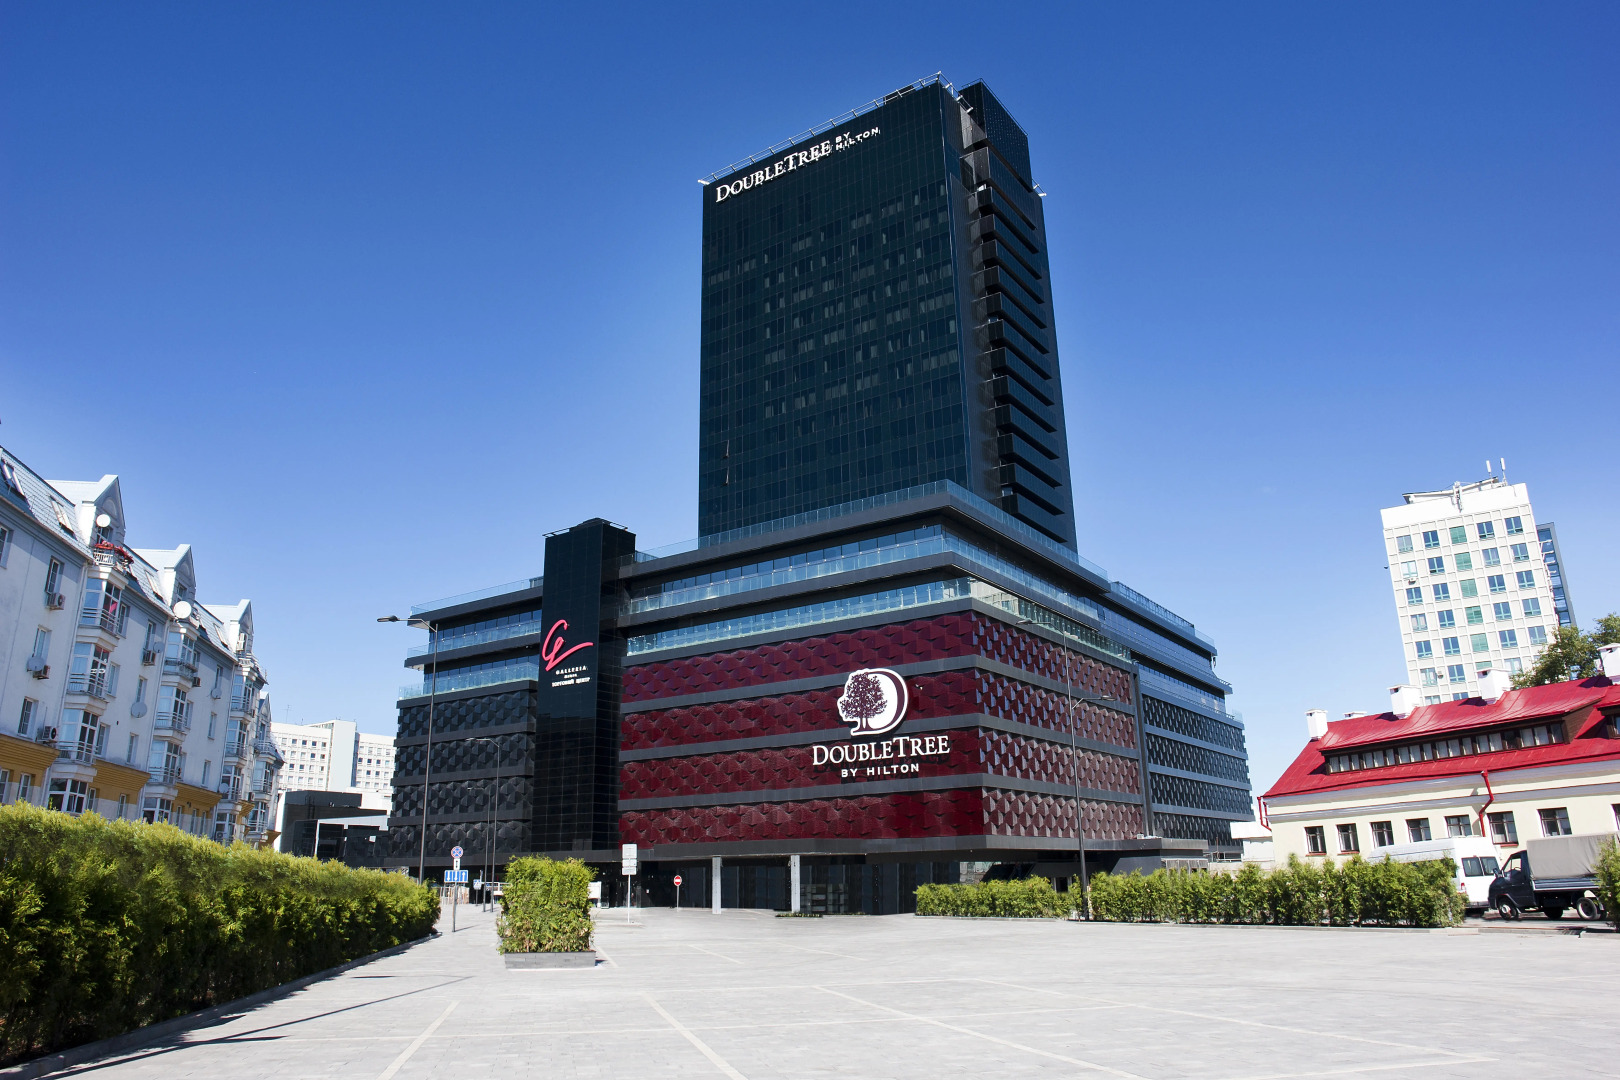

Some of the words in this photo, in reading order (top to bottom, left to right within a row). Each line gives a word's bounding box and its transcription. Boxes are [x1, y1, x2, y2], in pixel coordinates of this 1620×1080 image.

[835, 131, 850, 143] BY
[835, 126, 879, 151] HILTON
[716, 140, 831, 203] DOUBLETREE
[555, 665, 587, 675] GALLERIA
[812, 735, 950, 766] DOUBLETREE
[841, 768, 858, 778] BY
[866, 763, 919, 776] HILTON
